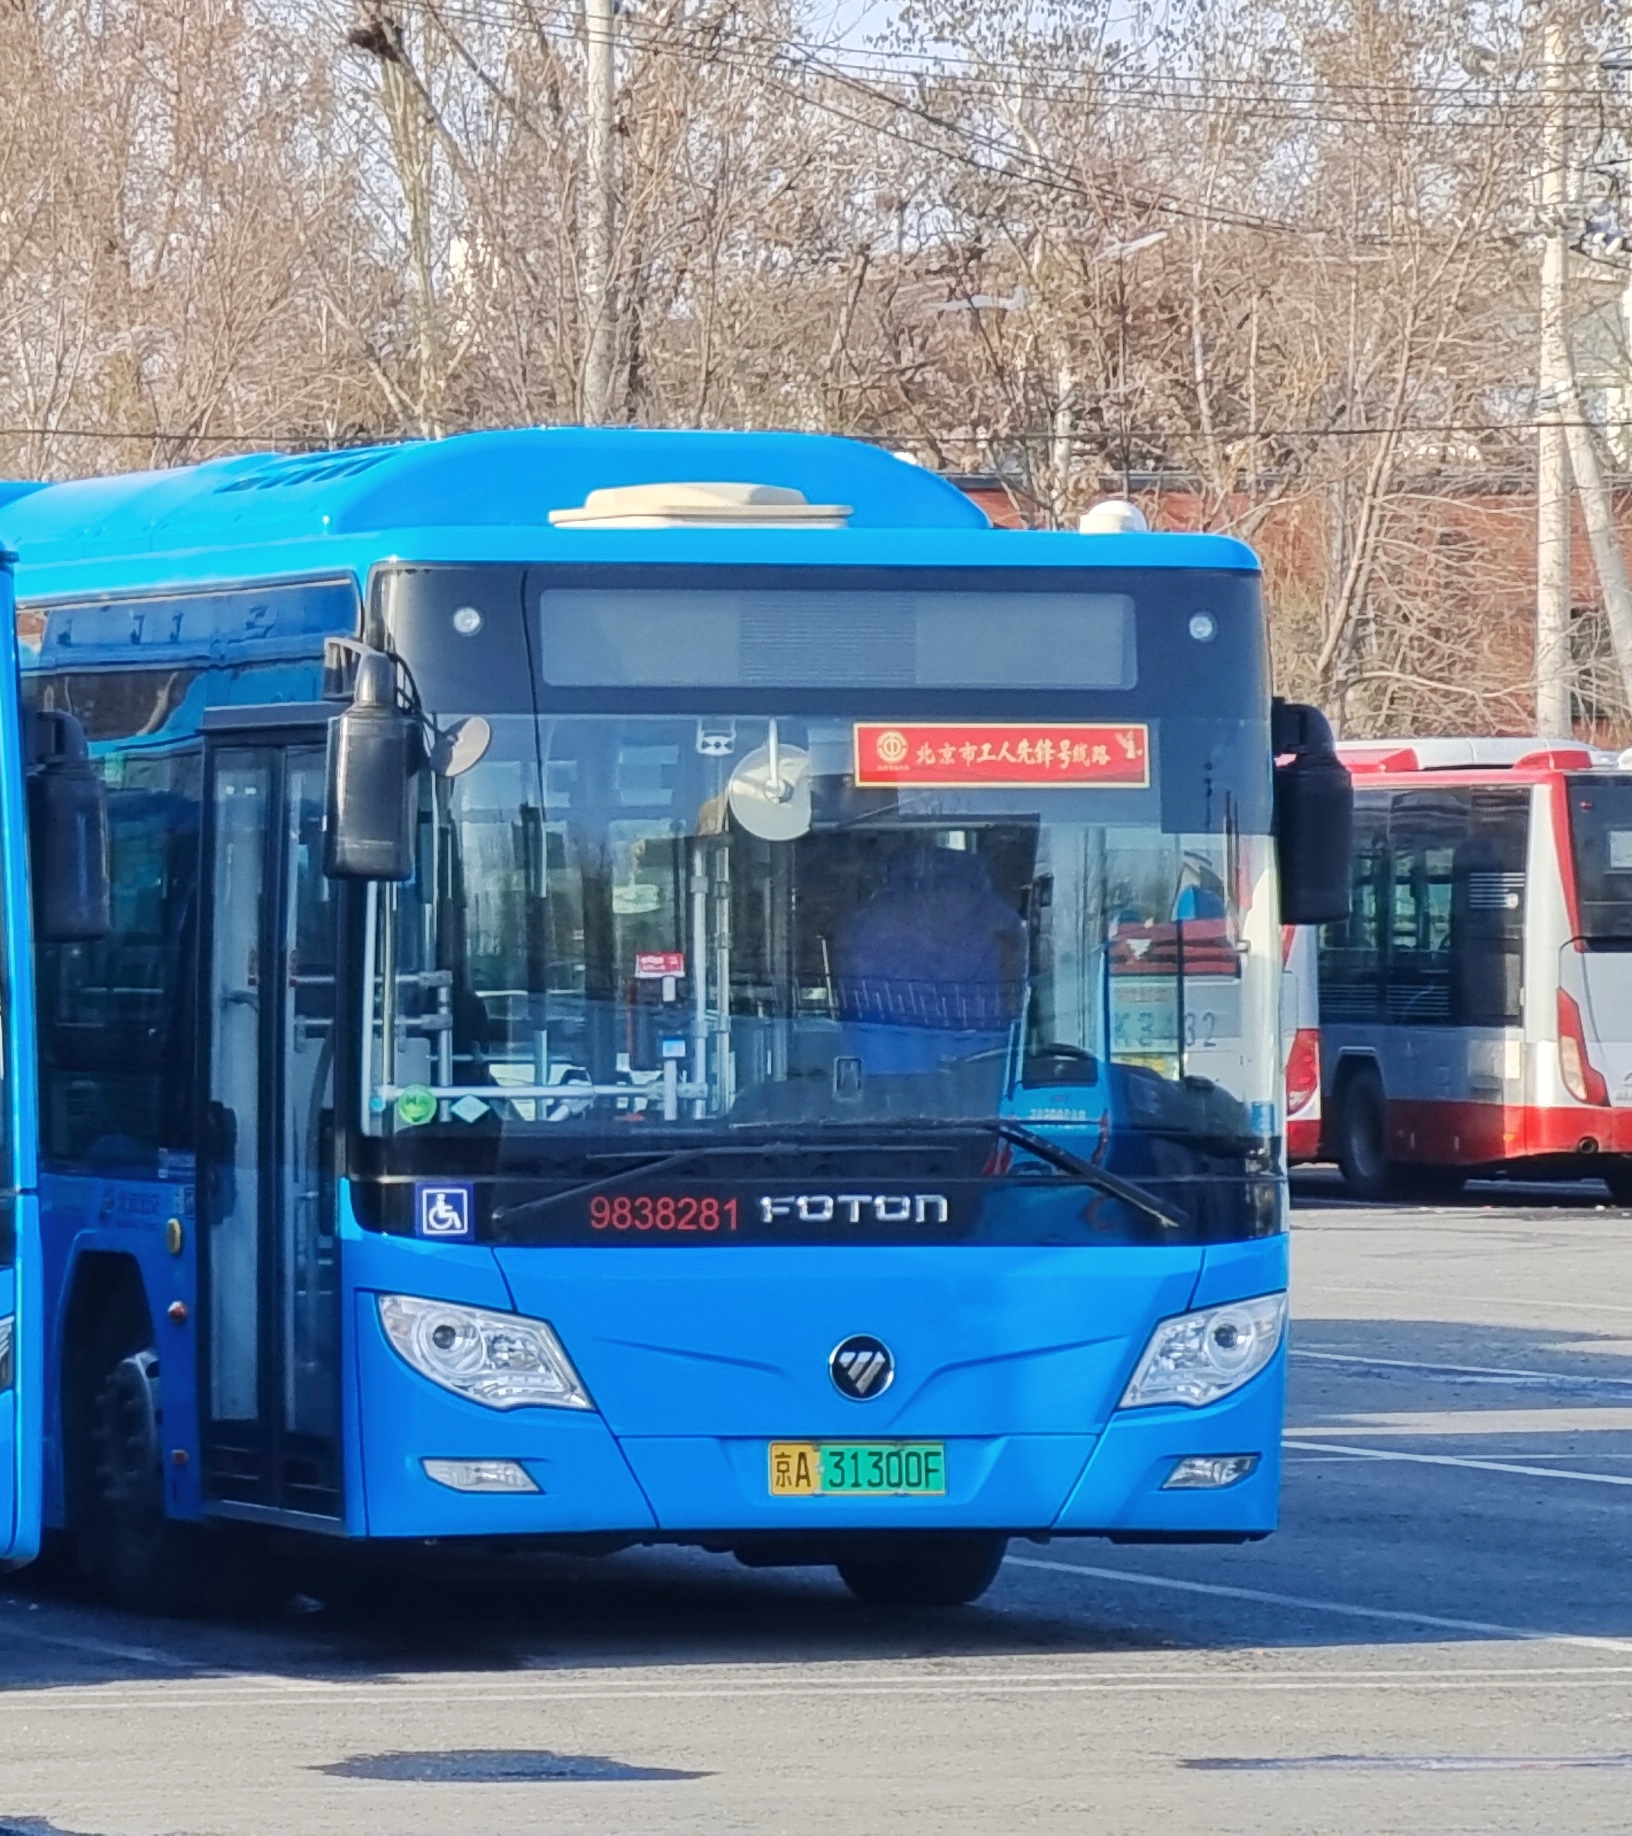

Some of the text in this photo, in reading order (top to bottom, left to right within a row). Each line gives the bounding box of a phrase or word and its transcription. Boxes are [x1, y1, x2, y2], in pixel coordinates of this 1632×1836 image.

[915, 738, 1112, 770] 北京市工人先锋号线路
[590, 1194, 948, 1231] 9838281 FOTON
